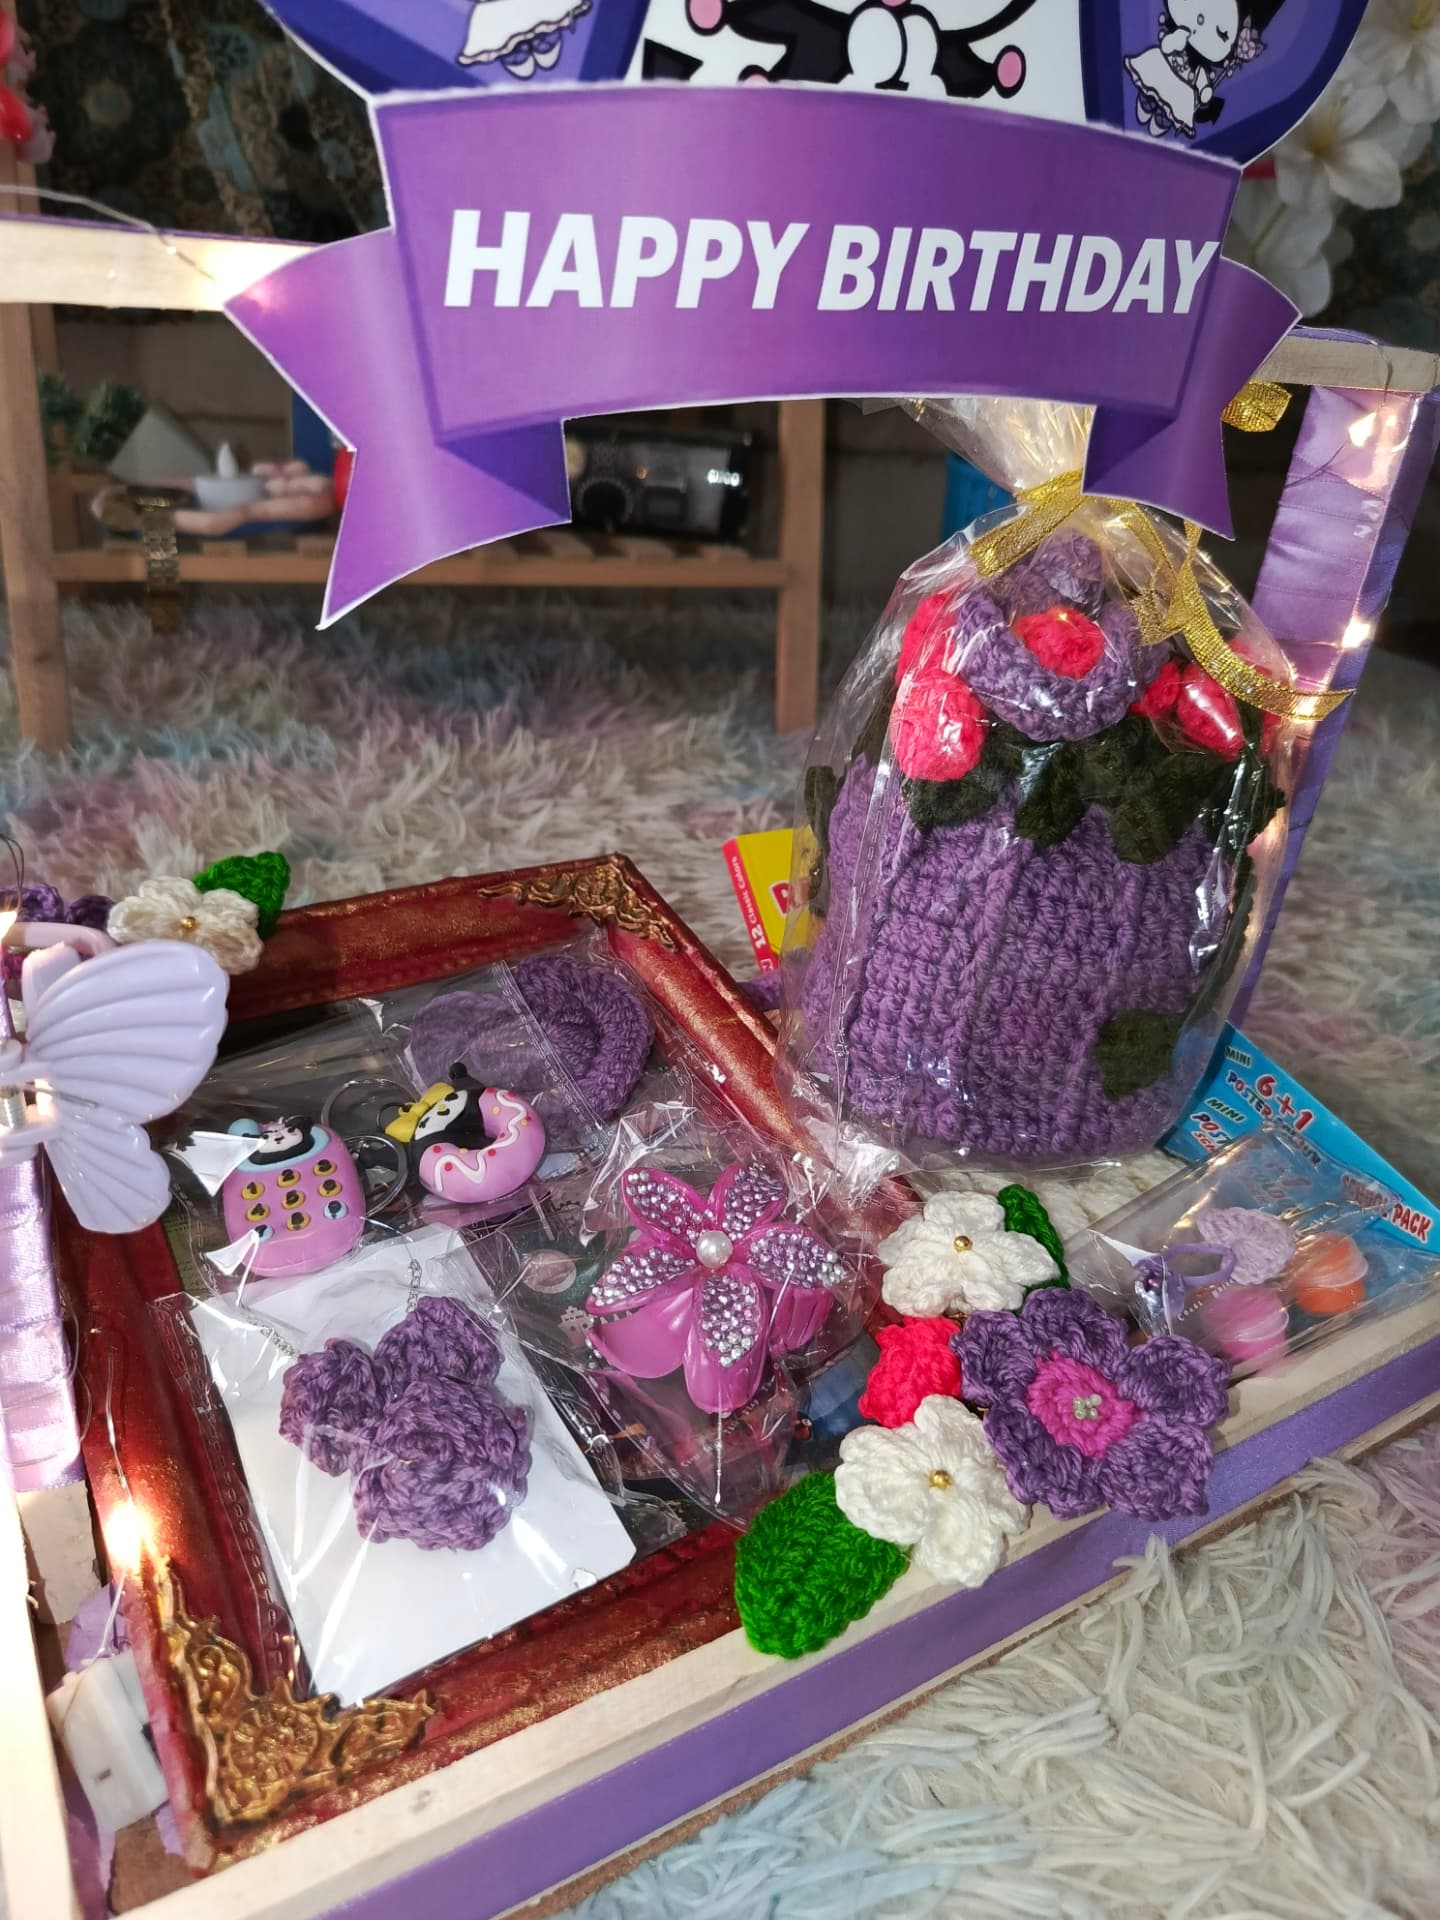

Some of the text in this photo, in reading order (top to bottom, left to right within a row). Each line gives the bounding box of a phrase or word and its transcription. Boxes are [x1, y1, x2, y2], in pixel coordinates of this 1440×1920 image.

[444, 209, 1220, 314] HAPPY BIRTHDAY
[751, 923, 767, 949] 12
[1224, 1046, 1252, 1068] MINI
[1226, 1070, 1273, 1117] POSTER
[1205, 1098, 1246, 1123] MINI
[1391, 1202, 1432, 1243] PACK
